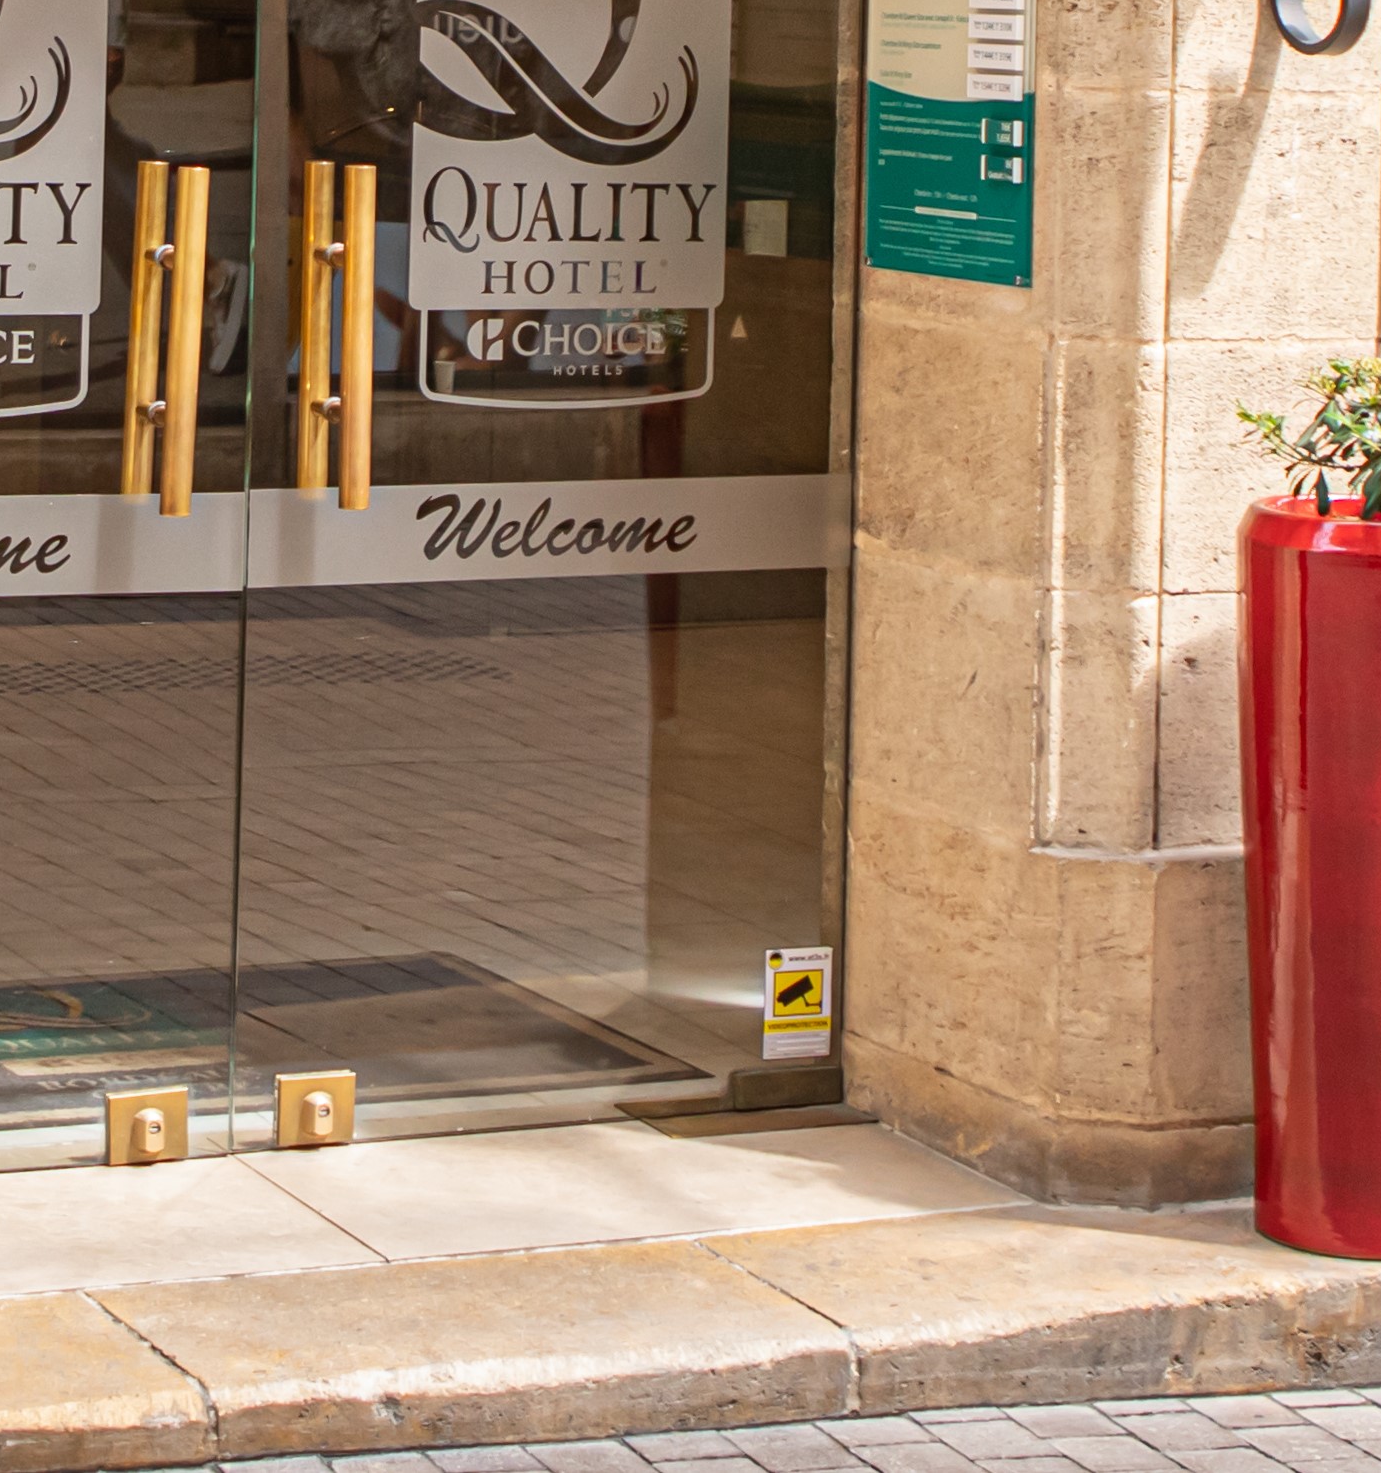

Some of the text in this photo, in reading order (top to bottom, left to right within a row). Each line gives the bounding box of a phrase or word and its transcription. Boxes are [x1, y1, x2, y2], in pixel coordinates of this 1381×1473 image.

[423, 166, 717, 253] QUALITY
[481, 259, 658, 295] HOTEL
[512, 320, 667, 356] CHOICE
[552, 364, 625, 376] HOTELS
[416, 493, 698, 561] Welcome
